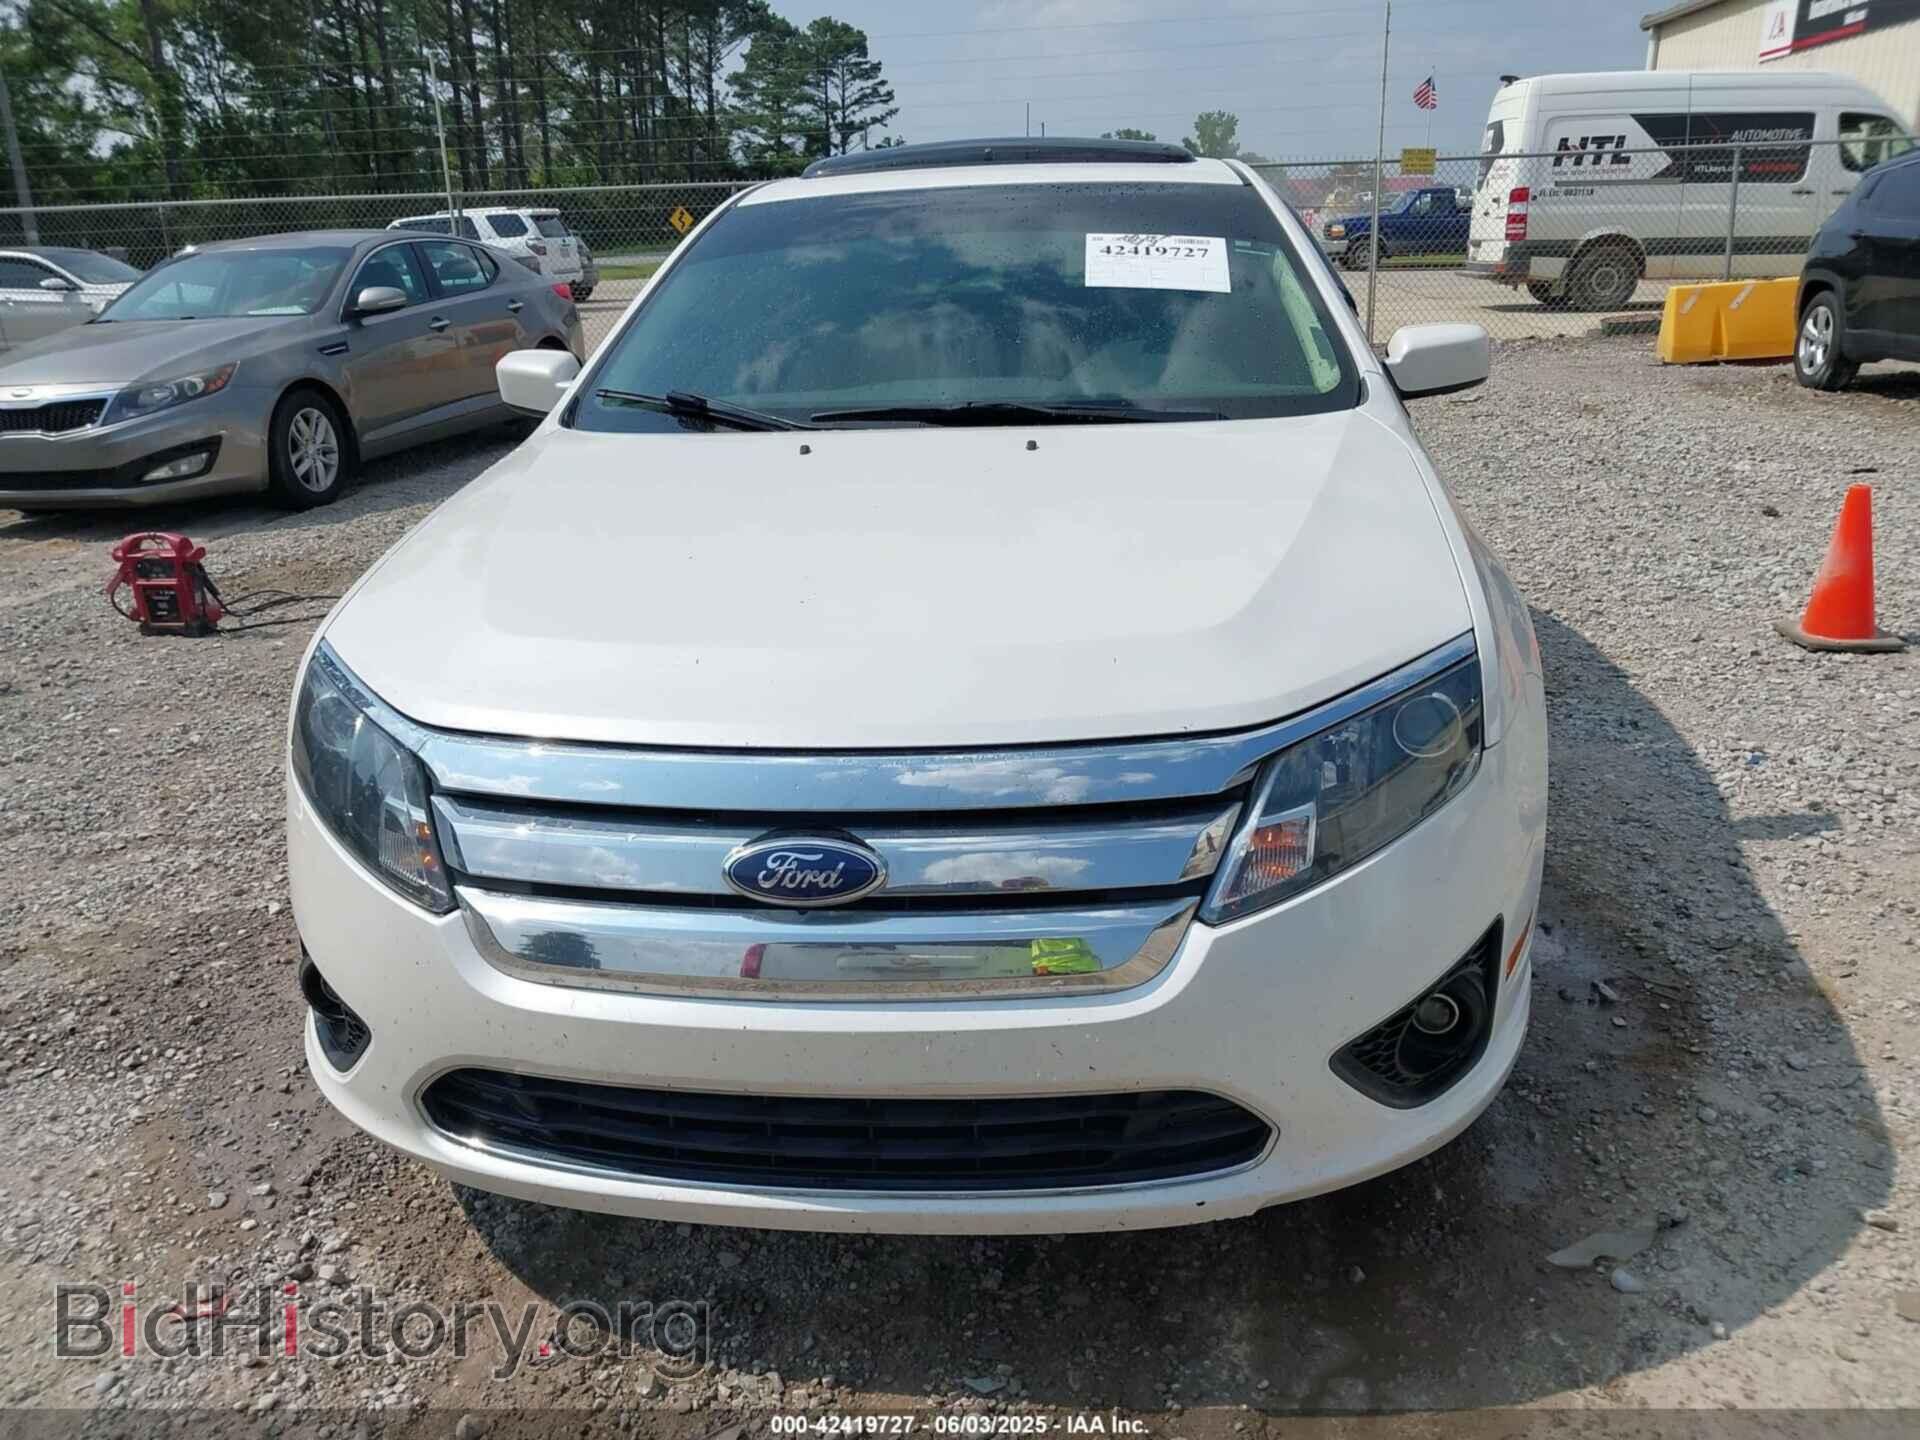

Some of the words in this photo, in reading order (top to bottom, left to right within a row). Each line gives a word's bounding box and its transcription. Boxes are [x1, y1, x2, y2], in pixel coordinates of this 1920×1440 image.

[1730, 127, 1804, 142] AUTOMOTIVE
[1553, 135, 1631, 167] HTL
[1100, 245, 1209, 258] 42419727
[757, 851, 846, 889] Ford
